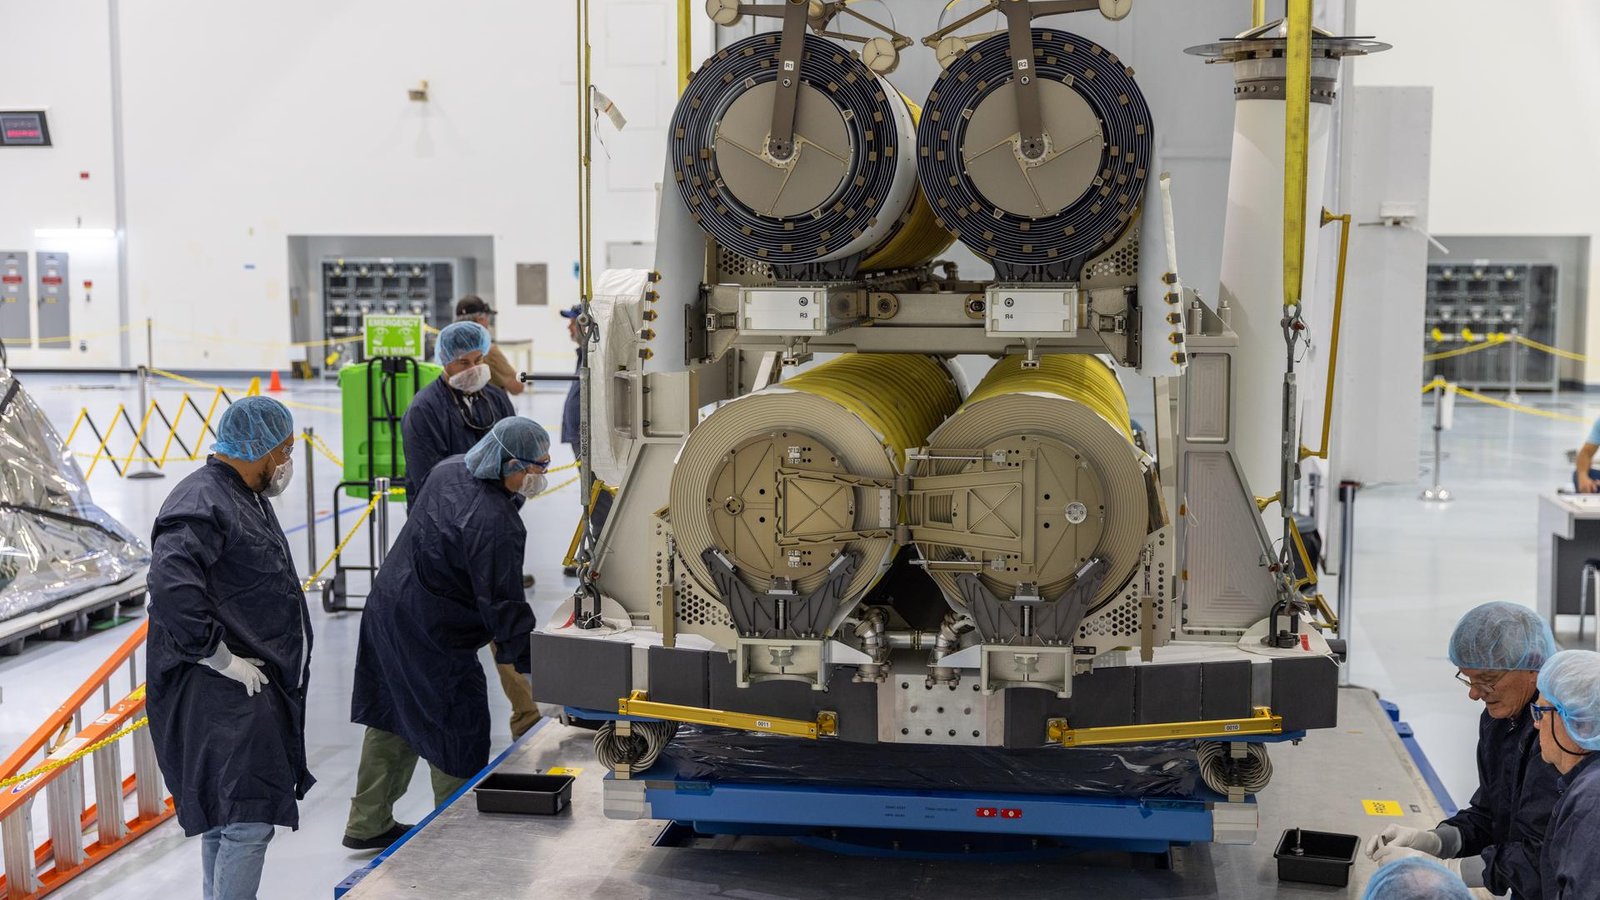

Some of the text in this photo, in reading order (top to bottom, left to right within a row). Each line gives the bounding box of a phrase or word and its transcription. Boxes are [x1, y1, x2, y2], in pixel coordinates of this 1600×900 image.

[368, 319, 418, 327] EMERGENCY
[372, 346, 415, 355] EYE WASH
